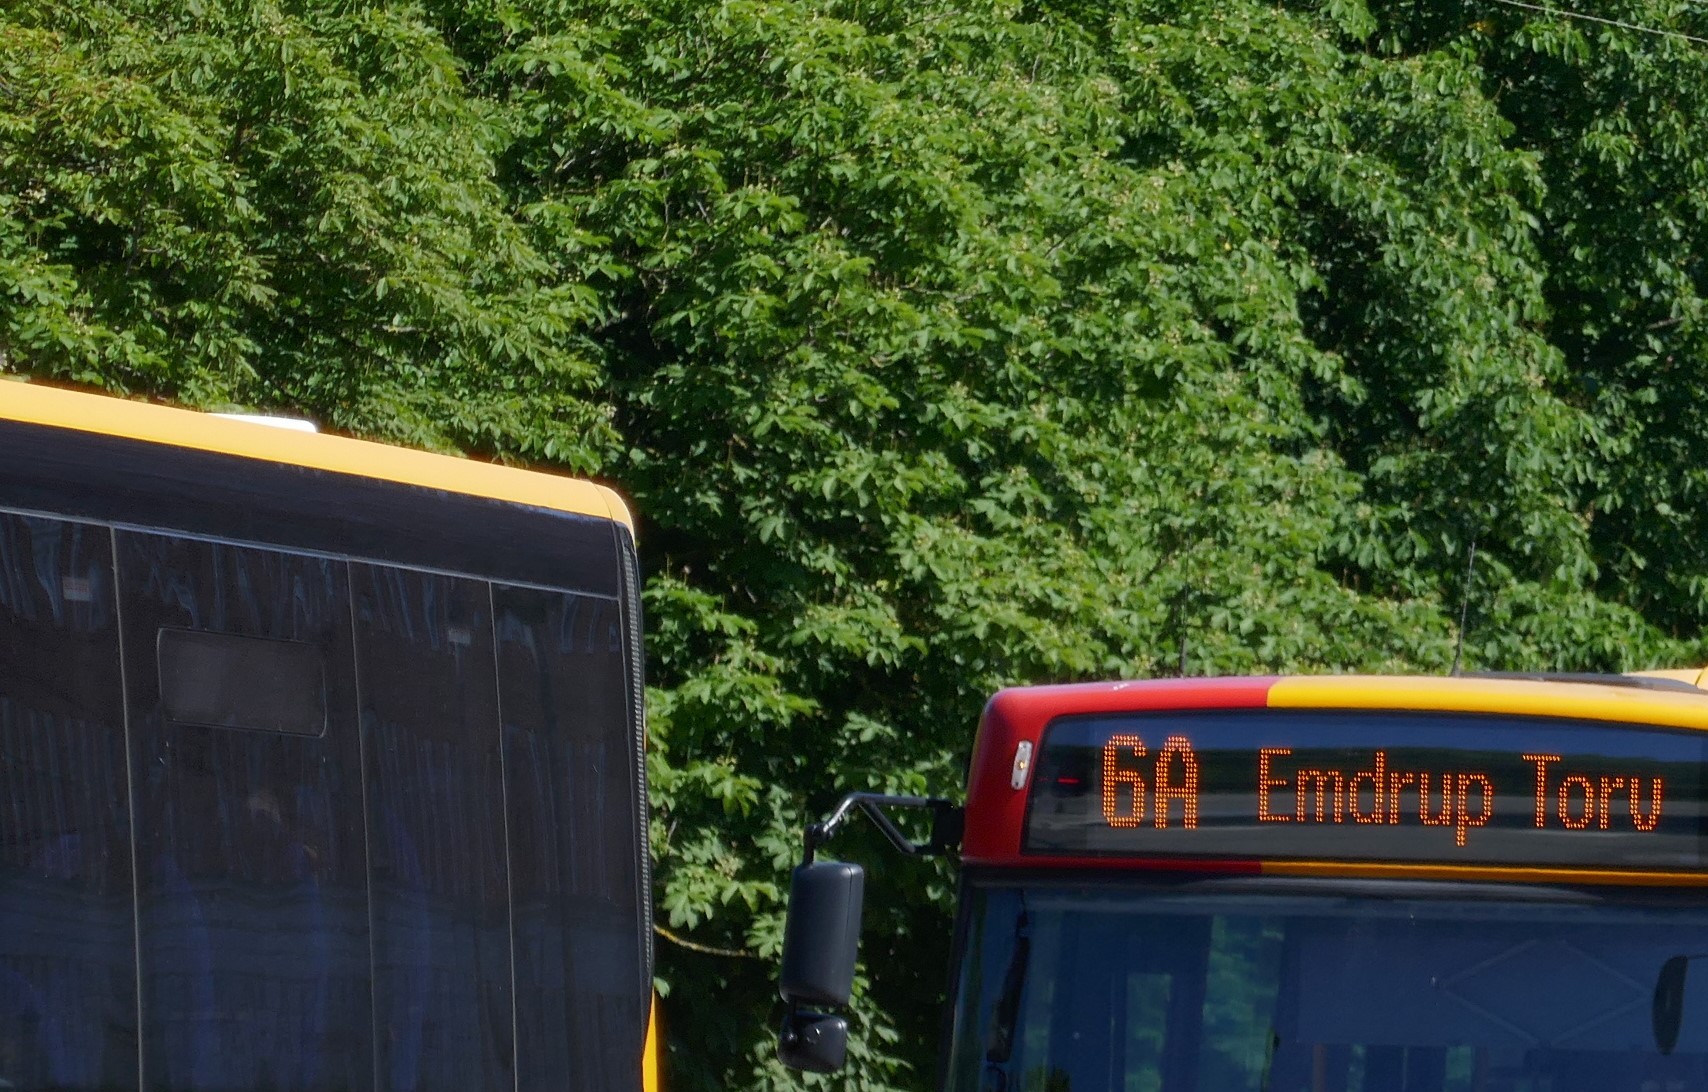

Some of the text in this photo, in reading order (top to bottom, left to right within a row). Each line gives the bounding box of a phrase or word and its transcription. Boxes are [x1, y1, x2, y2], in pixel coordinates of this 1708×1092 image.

[1102, 734, 1663, 848] 6A Emdrup Torv
